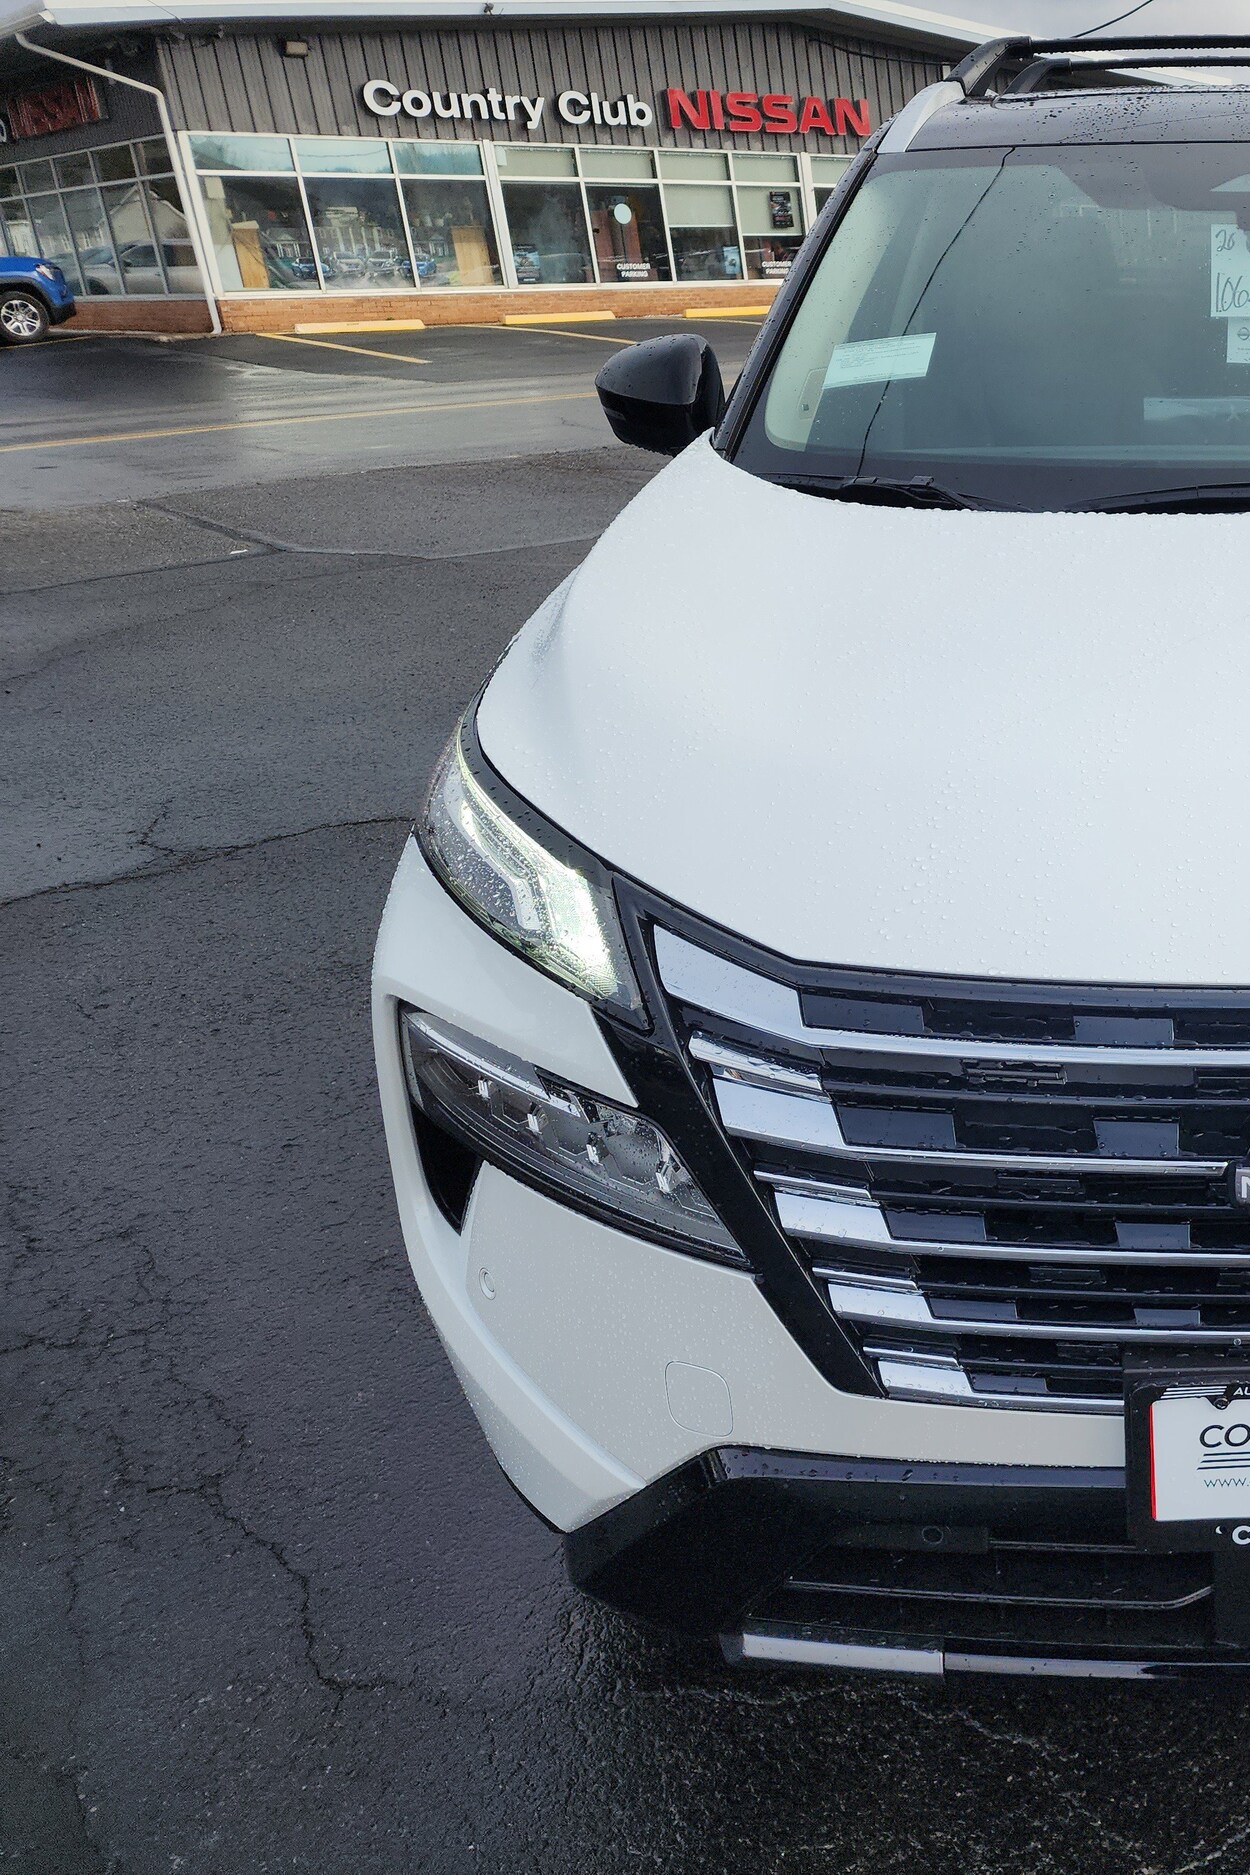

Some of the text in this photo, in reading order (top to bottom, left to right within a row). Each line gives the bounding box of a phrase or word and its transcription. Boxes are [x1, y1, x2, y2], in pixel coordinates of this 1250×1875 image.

[362, 79, 872, 136] Country Club NISSAN
[616, 262, 651, 270] CUSTOMER
